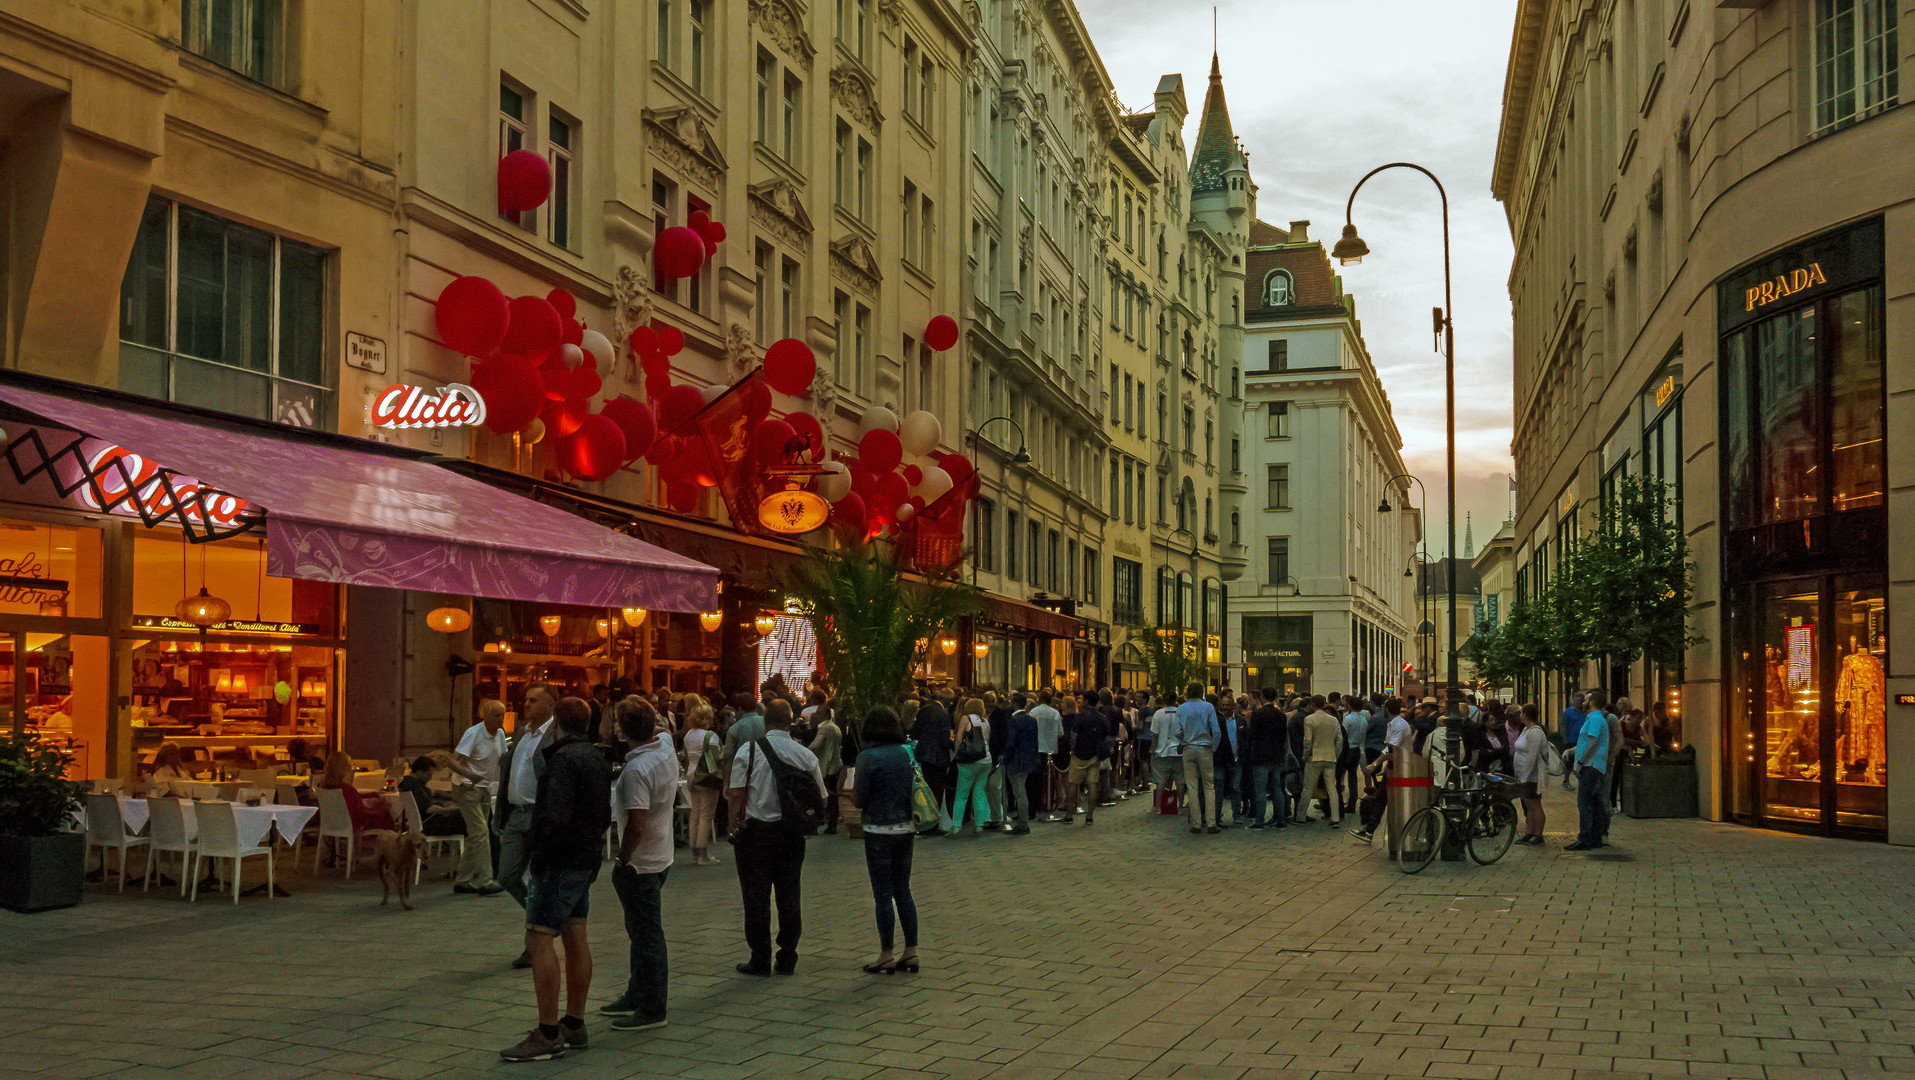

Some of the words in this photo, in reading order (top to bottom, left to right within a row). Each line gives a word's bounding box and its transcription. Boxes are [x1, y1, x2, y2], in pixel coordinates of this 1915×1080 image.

[1745, 262, 1827, 312] PRADA
[371, 383, 480, 429] Aida
[0, 551, 42, 578] afe
